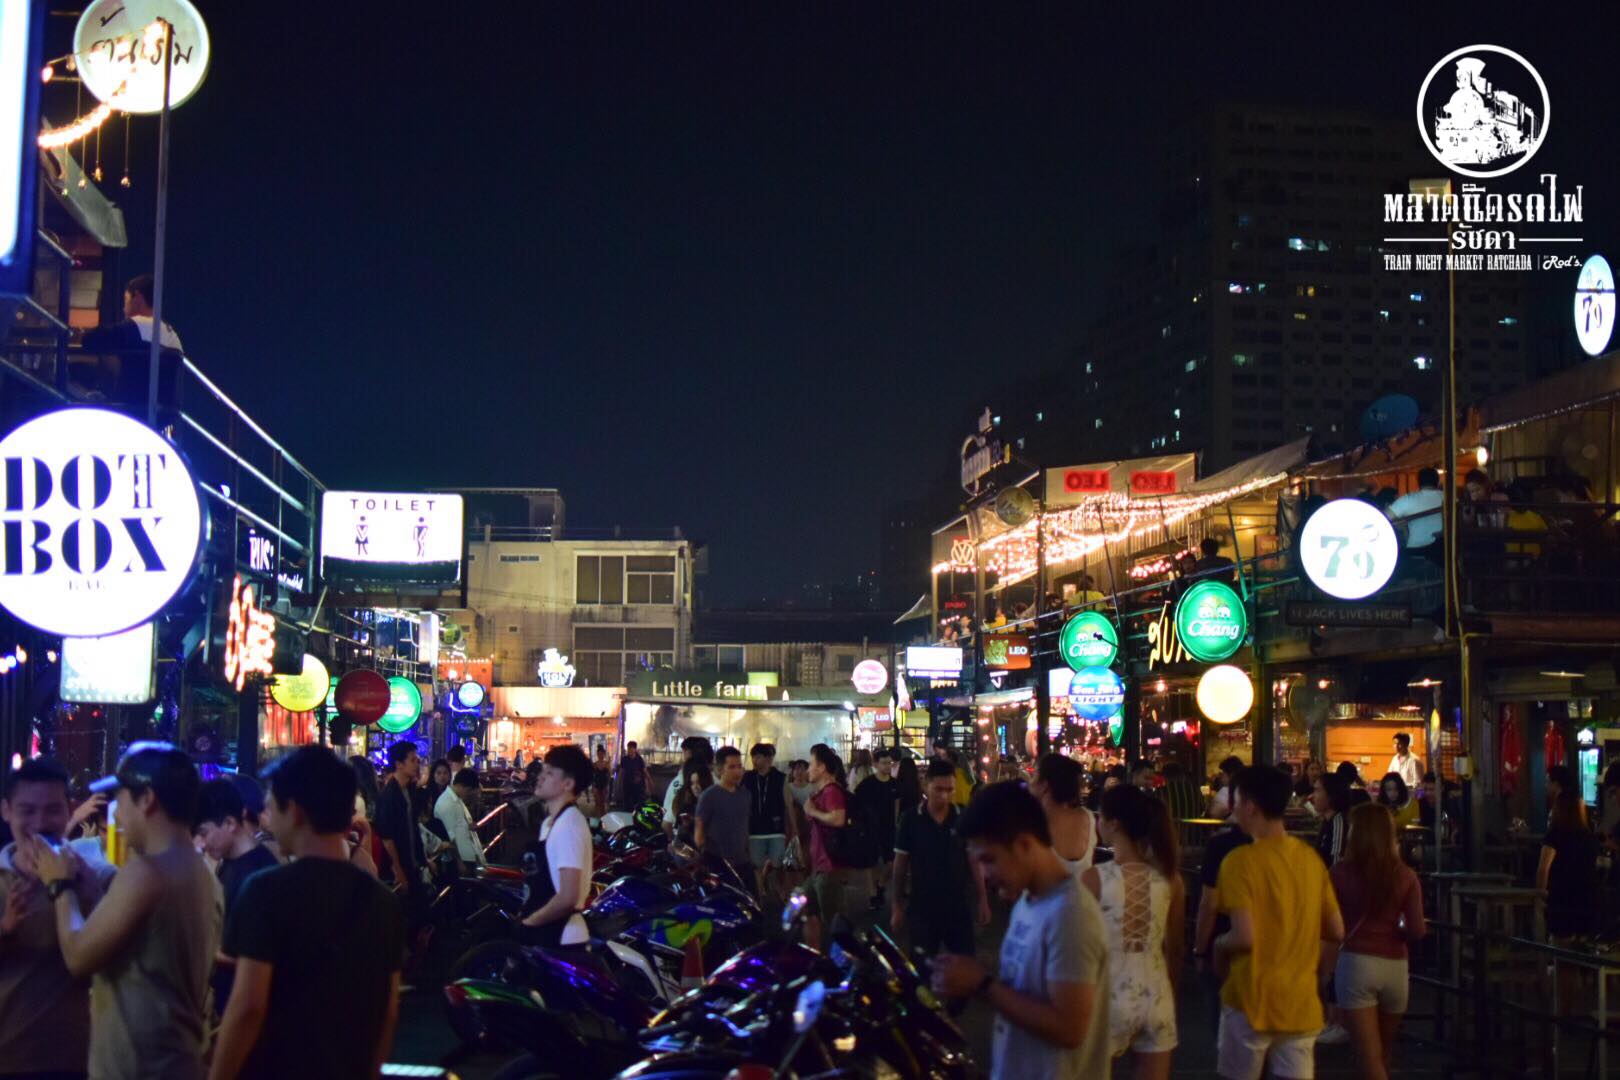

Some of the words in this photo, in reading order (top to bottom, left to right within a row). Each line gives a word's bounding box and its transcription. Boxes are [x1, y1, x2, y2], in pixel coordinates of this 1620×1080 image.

[4, 453, 166, 511] DOT
[350, 498, 437, 512] TOILET
[3, 517, 167, 575] BOX
[1340, 608, 1371, 619] LIVES
[1375, 608, 1407, 619] HERE
[1187, 620, 1240, 640] Chang
[1008, 646, 1028, 656] LEO
[1069, 642, 1112, 658] Chang
[652, 680, 703, 698] Little
[1074, 696, 1115, 704] LIGHT
[875, 713, 890, 722] LEO
